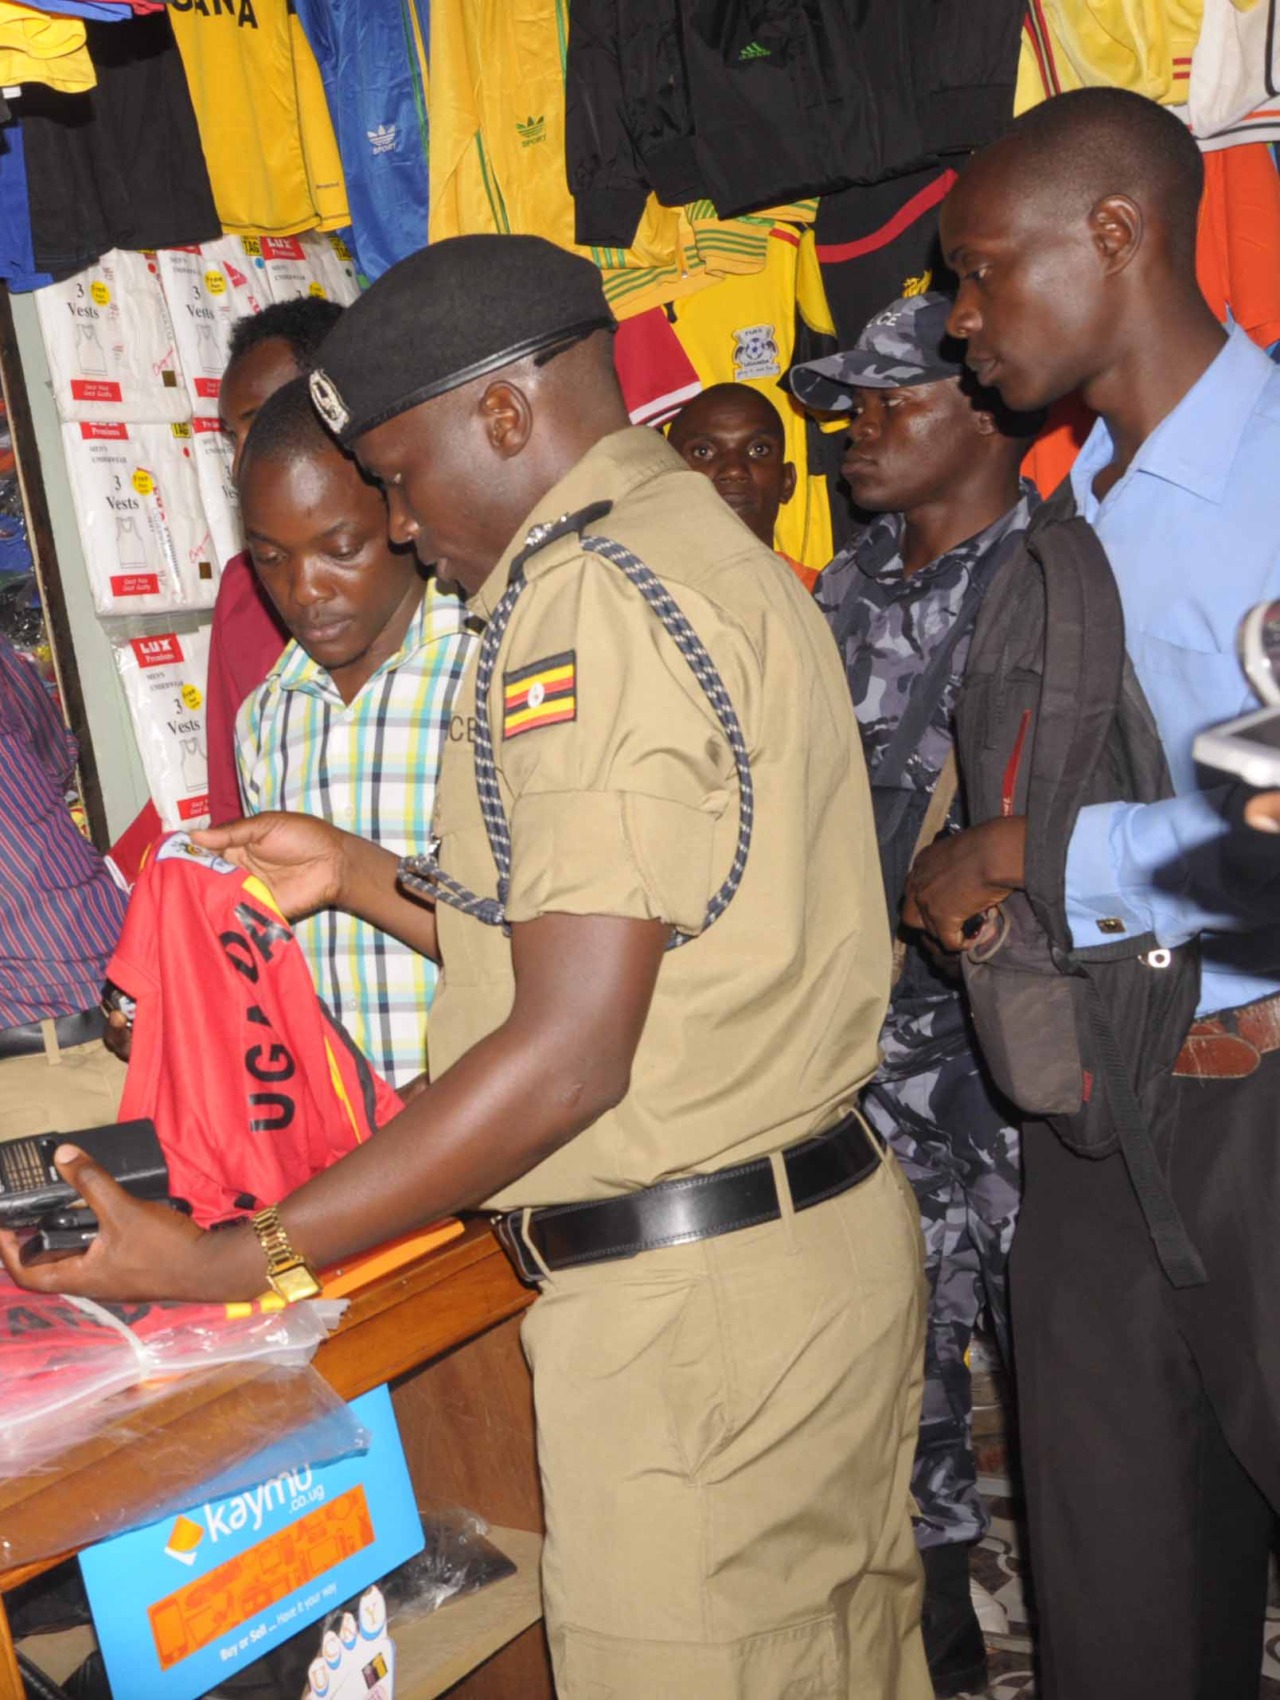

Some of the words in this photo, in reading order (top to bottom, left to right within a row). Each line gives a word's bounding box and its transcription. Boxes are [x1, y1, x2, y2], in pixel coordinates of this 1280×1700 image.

[76, 282, 85, 298] 3
[192, 285, 201, 300] 3
[67, 301, 100, 320] Vests
[186, 303, 215, 320] Vests
[114, 475, 122, 492] 3
[106, 495, 139, 511] Vests
[139, 639, 173, 655] LUX
[173, 697, 183, 716] 3
[167, 718, 201, 736] Vests
[203, 1463, 312, 1542] kaymu
